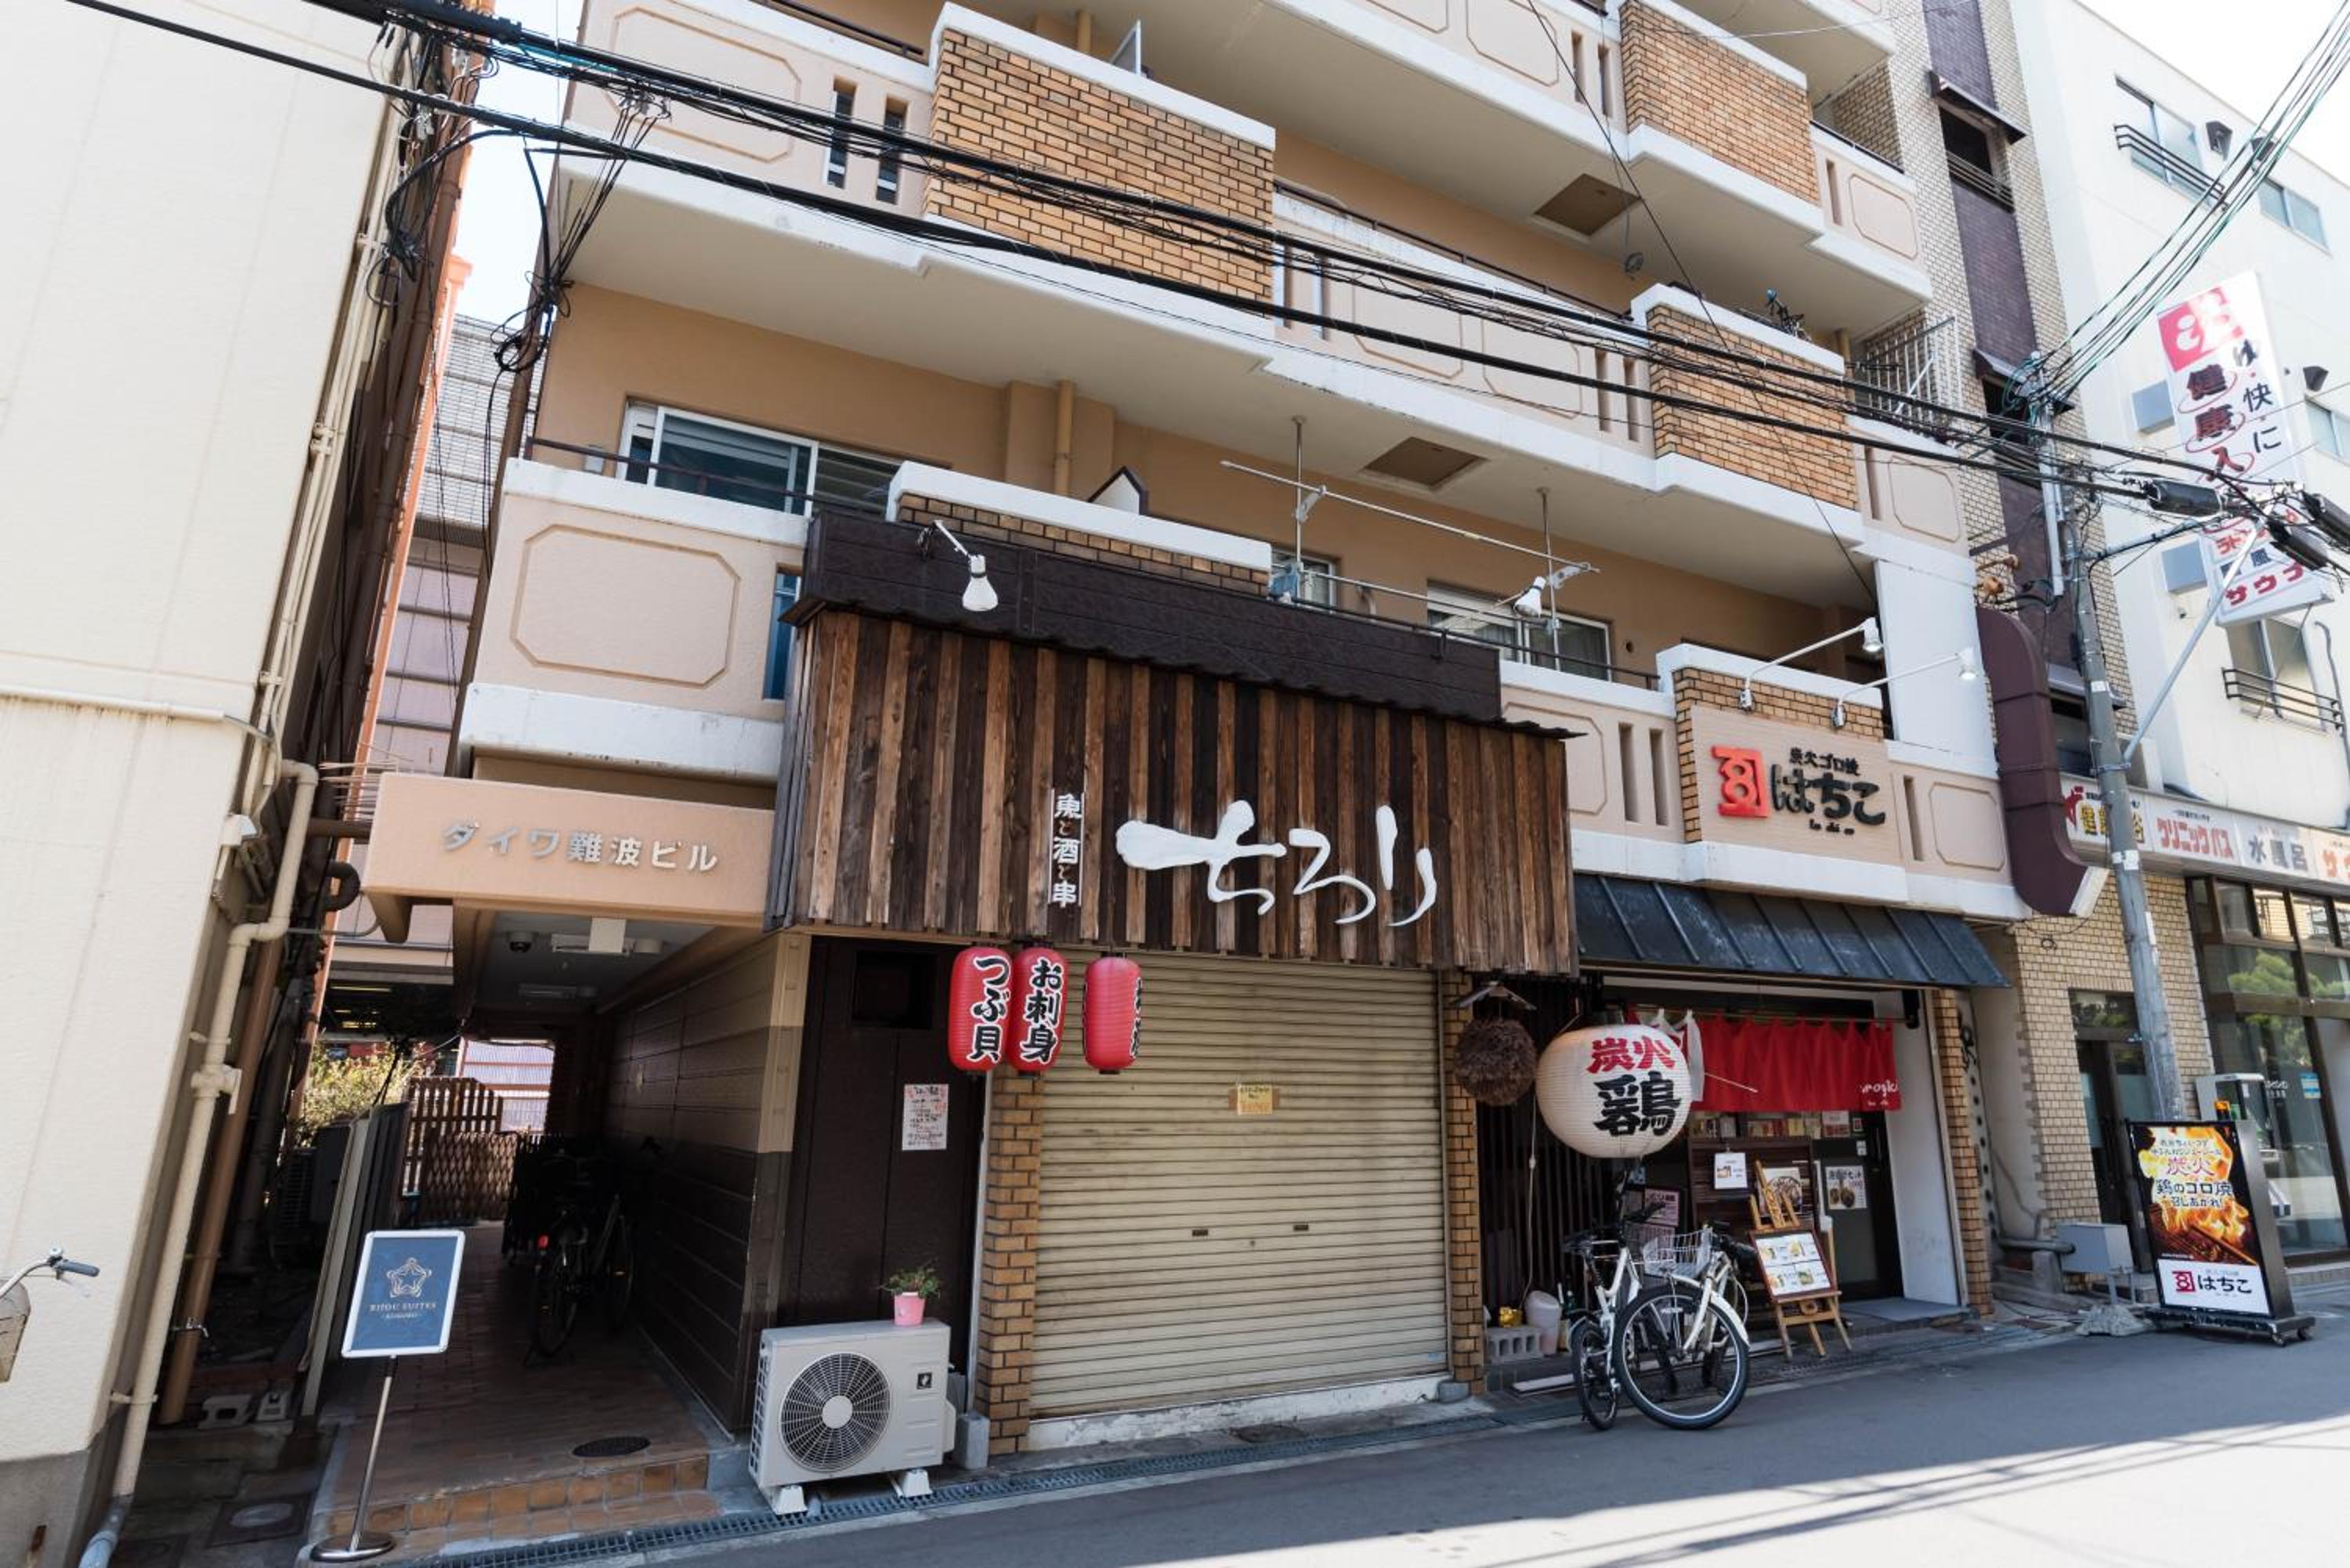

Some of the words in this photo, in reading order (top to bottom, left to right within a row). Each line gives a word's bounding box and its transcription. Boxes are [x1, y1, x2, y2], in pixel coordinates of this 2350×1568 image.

[1771, 764, 1885, 826] はちこ
[443, 822, 718, 873] ダイワ難波ビル
[1053, 793, 1083, 909] 魚と酒と串
[1115, 800, 1437, 927] ちろり
[967, 955, 1011, 1063] つぶ貝
[1020, 957, 1063, 1064] お刺身
[1586, 1035, 1676, 1074] 炭火
[2167, 1157, 2214, 1176] 炭火
[2197, 1274, 2252, 1294] はちこ
